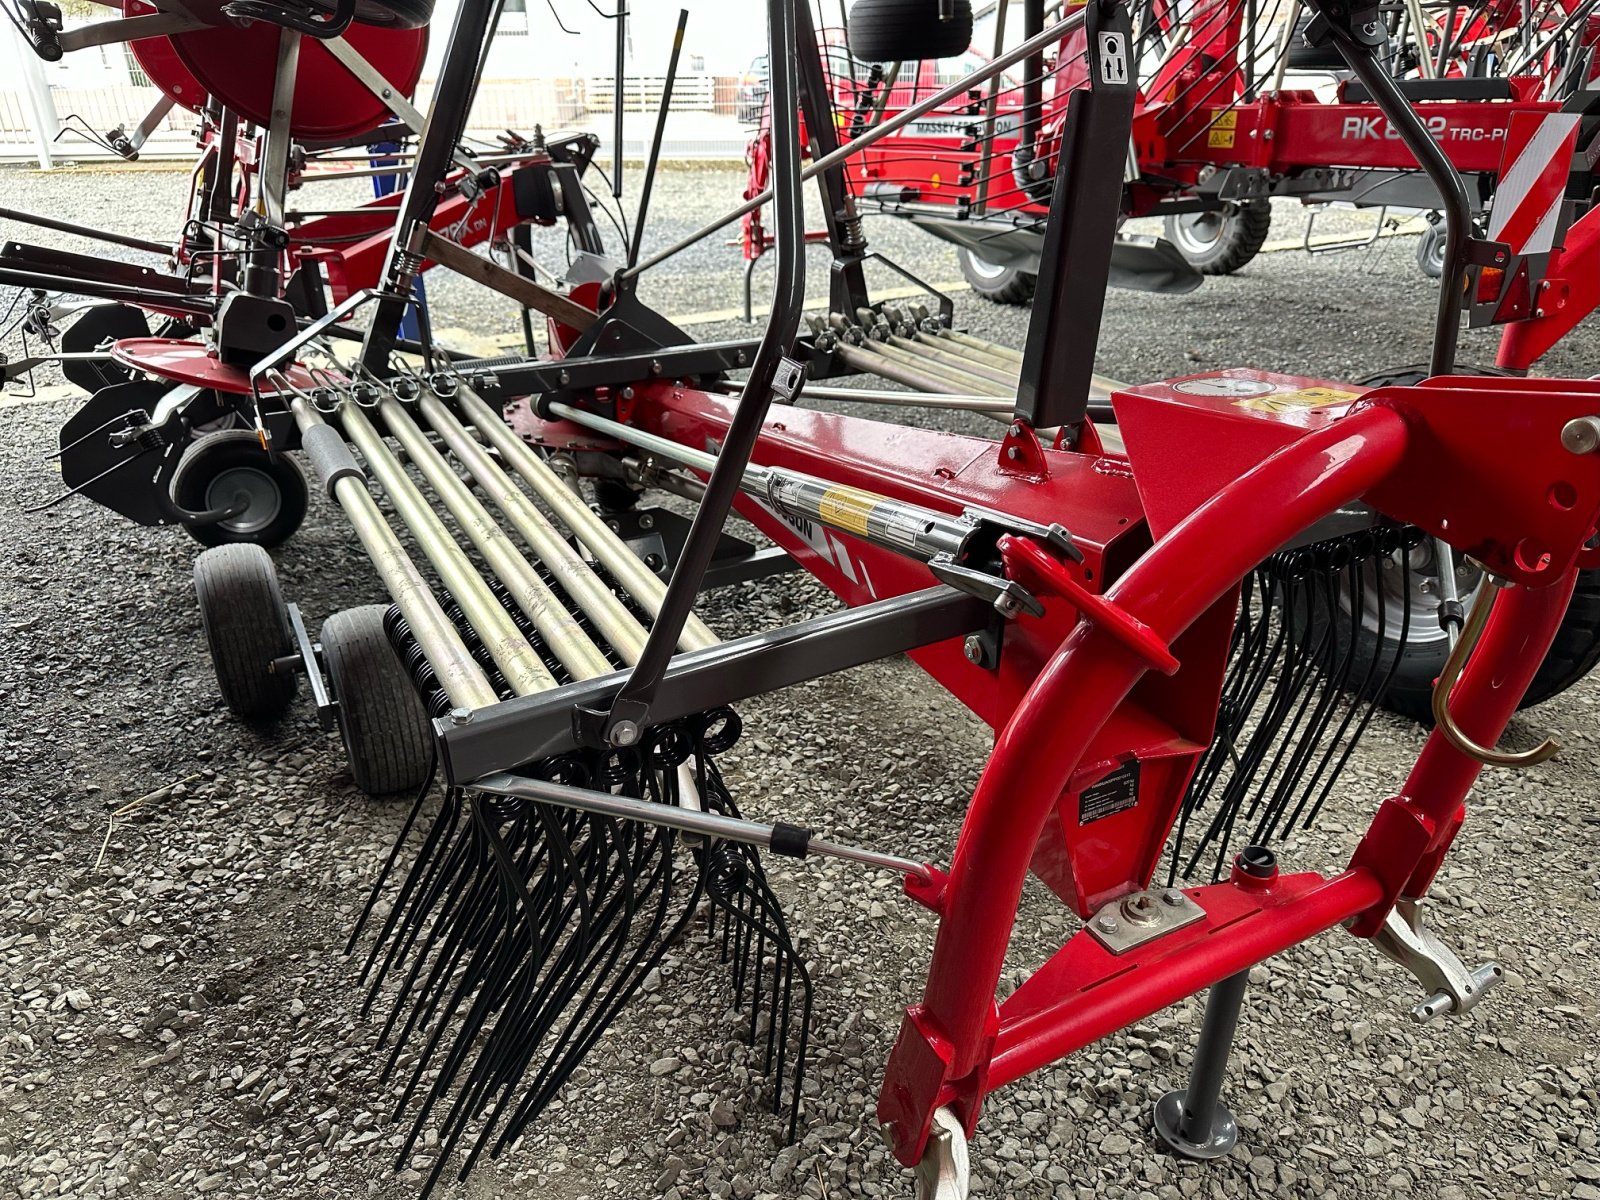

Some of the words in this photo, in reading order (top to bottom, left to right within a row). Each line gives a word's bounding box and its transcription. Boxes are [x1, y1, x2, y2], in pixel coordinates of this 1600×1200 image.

[917, 121, 954, 133] MASSEY
[1342, 117, 1381, 139] RK
[1385, 117, 1446, 140] 82
[1450, 128, 1507, 140] TRC-P
